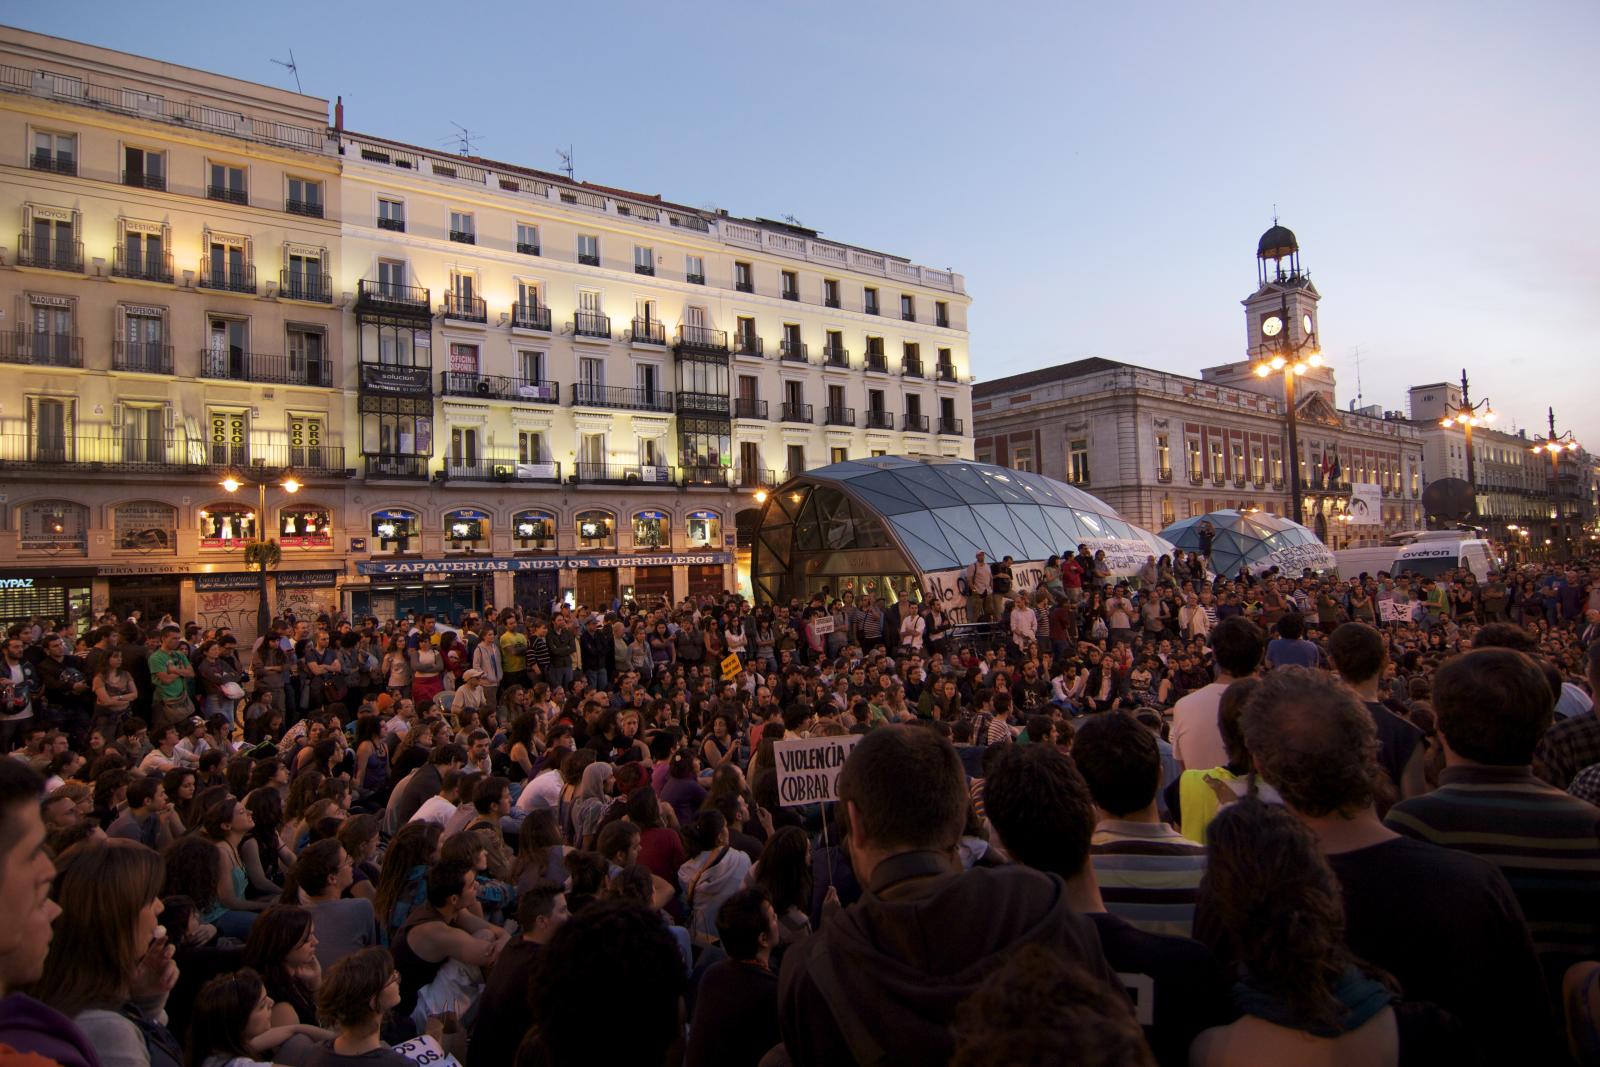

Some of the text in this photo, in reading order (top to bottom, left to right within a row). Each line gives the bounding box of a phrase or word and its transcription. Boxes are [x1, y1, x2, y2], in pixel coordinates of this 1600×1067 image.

[38, 210, 68, 219] HOYOS
[214, 236, 240, 244] HOYOS
[31, 295, 70, 307] MAQUILLAJE
[126, 305, 161, 316] PROFESIONAL
[213, 420, 225, 442] ORO
[231, 421, 243, 443] ORO
[292, 424, 303, 445] ORO
[308, 425, 319, 446] ORO
[1402, 550, 1450, 558] overon
[385, 561, 508, 573] ZAPATERIAS
[519, 560, 588, 569] NUEVOS
[598, 556, 713, 568] GUERRILLEROS
[1016, 568, 1031, 587] UN
[781, 774, 830, 802] COBRAR
